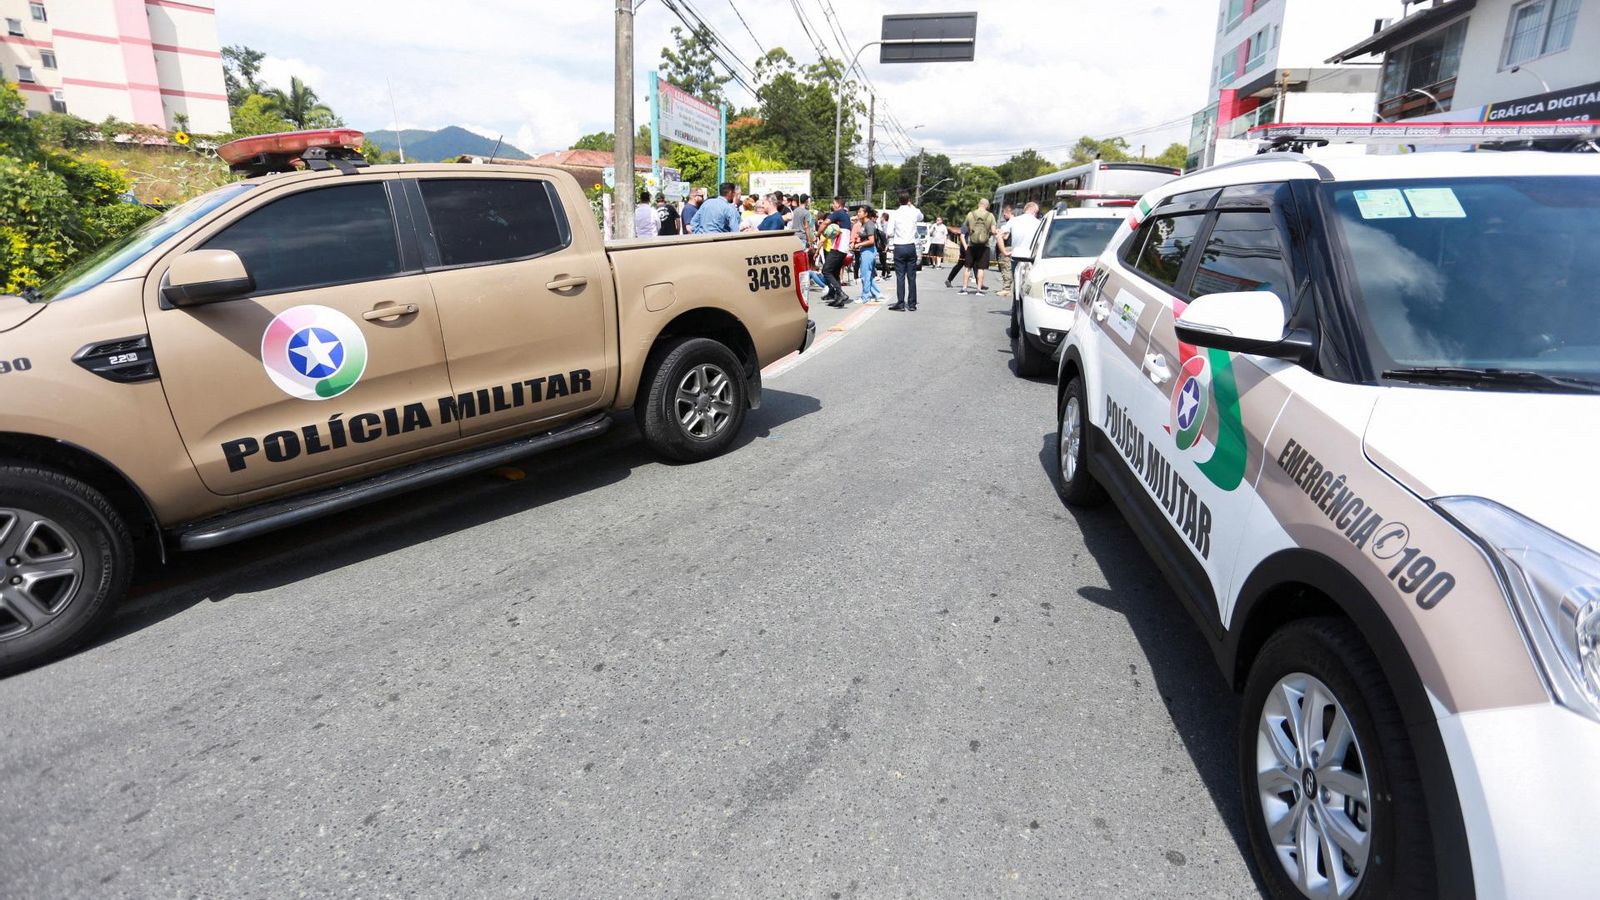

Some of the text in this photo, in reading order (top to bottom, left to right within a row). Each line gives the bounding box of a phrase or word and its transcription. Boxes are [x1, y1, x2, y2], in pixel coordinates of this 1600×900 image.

[1489, 102, 1544, 120] GRÁFICA
[745, 253, 789, 266] TÁTICO
[747, 265, 791, 292] 3438
[221, 369, 591, 472] POLÍCIA MILITAR
[1104, 394, 1145, 476] POLÍCIA
[1144, 441, 1212, 561] MILITAR
[1277, 437, 1456, 611] EMERGÊNCIA 190
